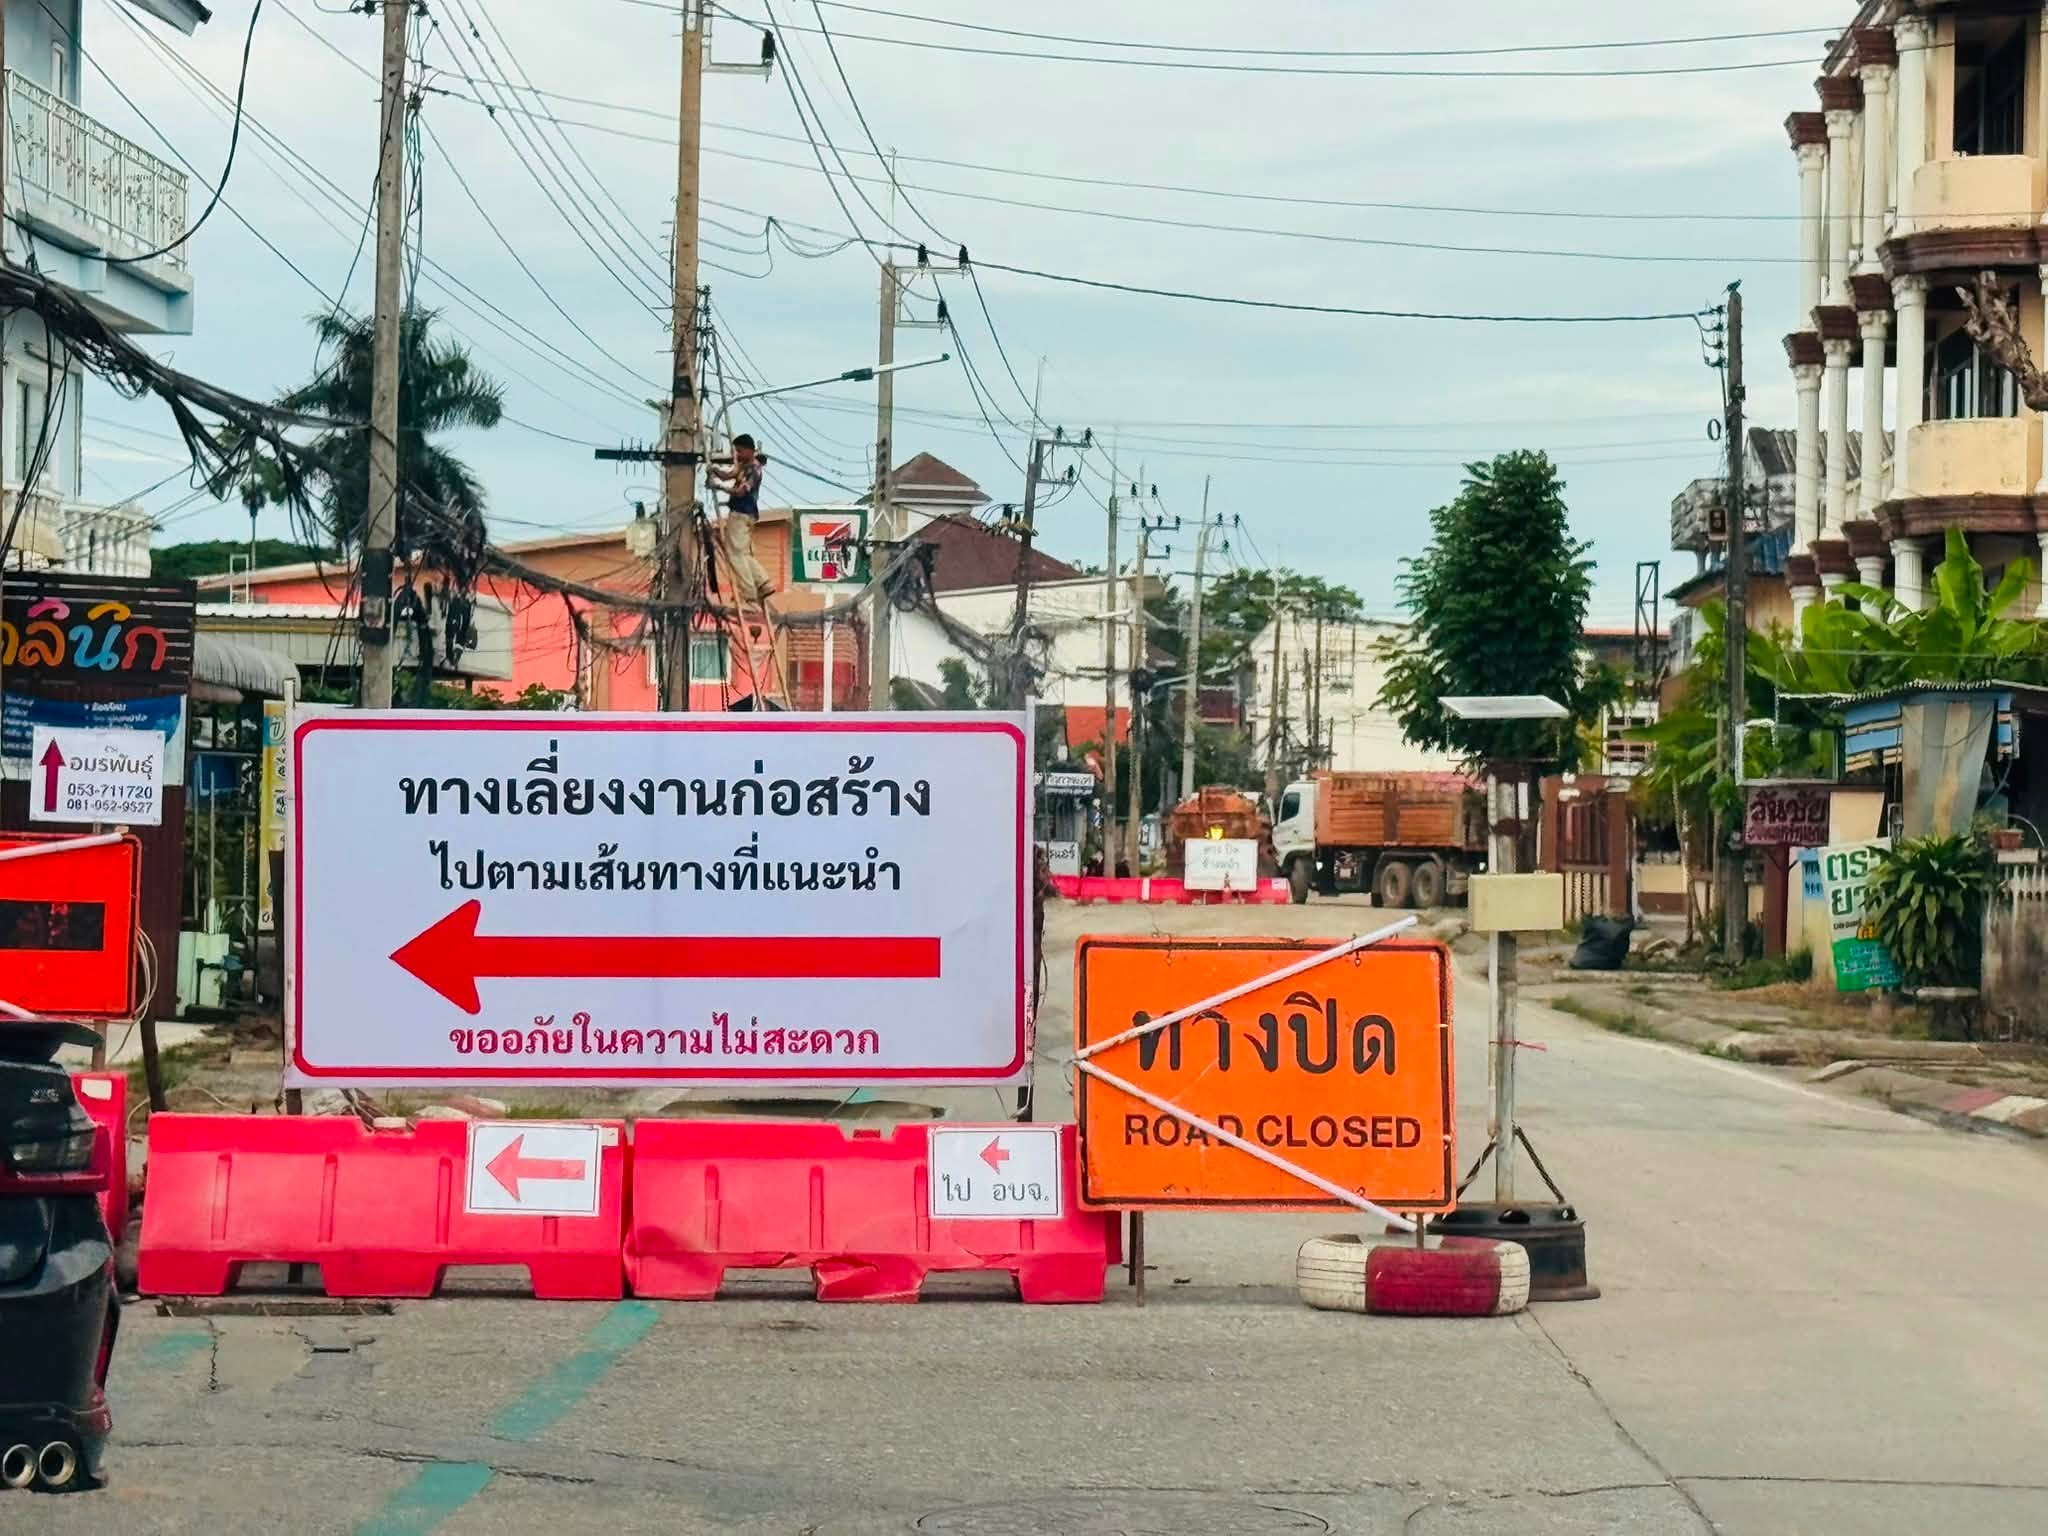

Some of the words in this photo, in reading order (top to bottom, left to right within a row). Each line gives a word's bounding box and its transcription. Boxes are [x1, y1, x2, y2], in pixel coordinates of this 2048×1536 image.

[67, 783, 153, 799] 053-711720
[398, 739, 932, 818] ทางเลี่ยงงานก่อสร้าง
[428, 831, 902, 892] ไปตามเส้นทางที่แนะนำ
[449, 1012, 880, 1055] ขออภัยในความไม่สะดวก
[1132, 991, 1396, 1075] ทางปิด
[1125, 1114, 1243, 1146] ROAD
[1256, 1114, 1421, 1148] CLOSED
[942, 1173, 971, 1201] ไป
[993, 1183, 1049, 1201] อบจ.
